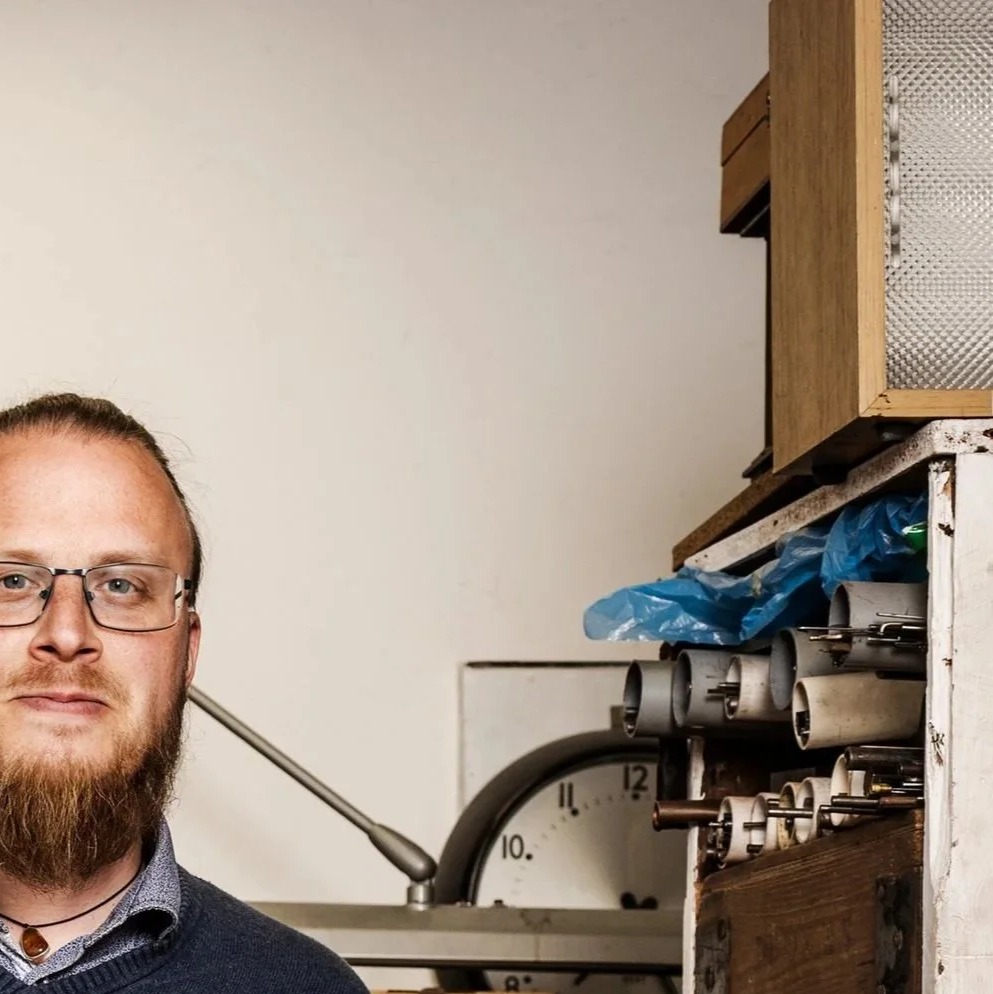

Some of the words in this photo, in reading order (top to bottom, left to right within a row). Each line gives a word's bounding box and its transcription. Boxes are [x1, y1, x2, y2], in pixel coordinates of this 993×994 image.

[623, 765, 649, 792] 12
[559, 782, 575, 809] 11
[502, 834, 525, 861] 10
